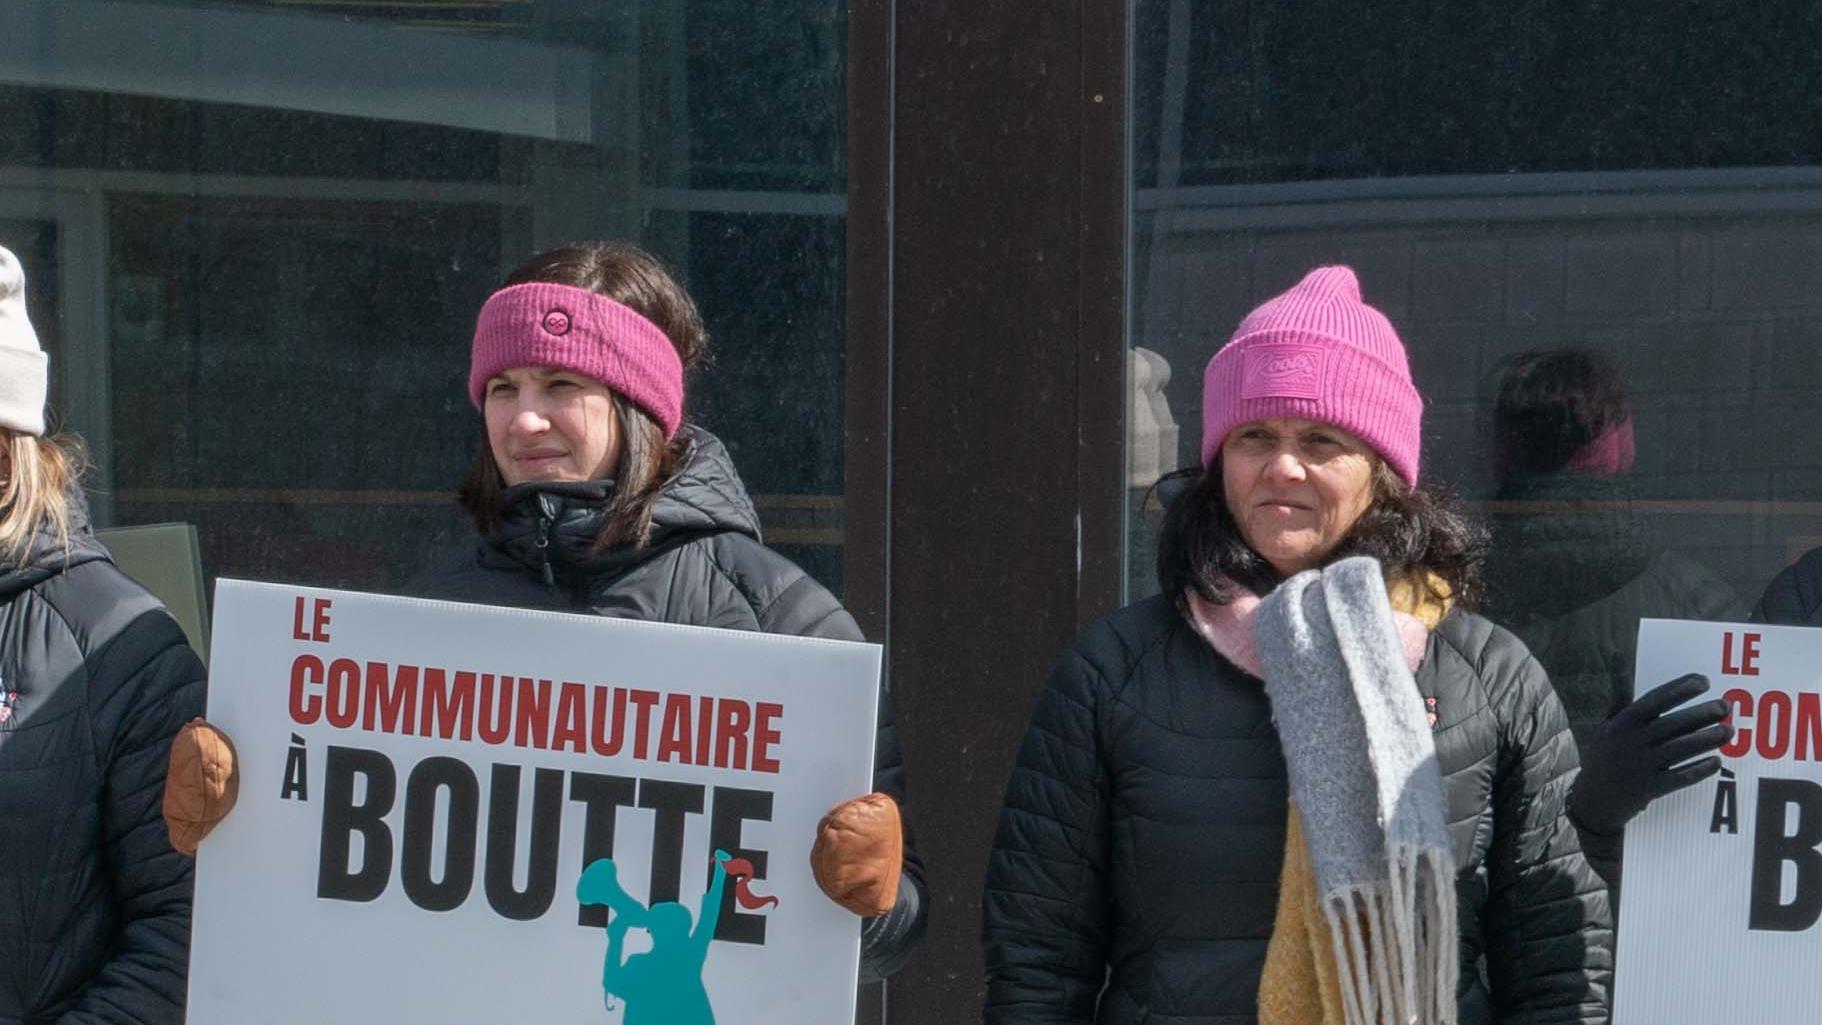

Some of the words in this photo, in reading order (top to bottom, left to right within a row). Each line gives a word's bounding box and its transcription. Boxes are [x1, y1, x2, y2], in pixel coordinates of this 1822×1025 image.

[293, 596, 332, 643] LE
[1721, 631, 1761, 676] LE
[288, 654, 784, 774] COMMUNAUTAIRE
[1709, 766, 1739, 835] À
[280, 732, 309, 802] À
[316, 744, 775, 946] BOUTTE
